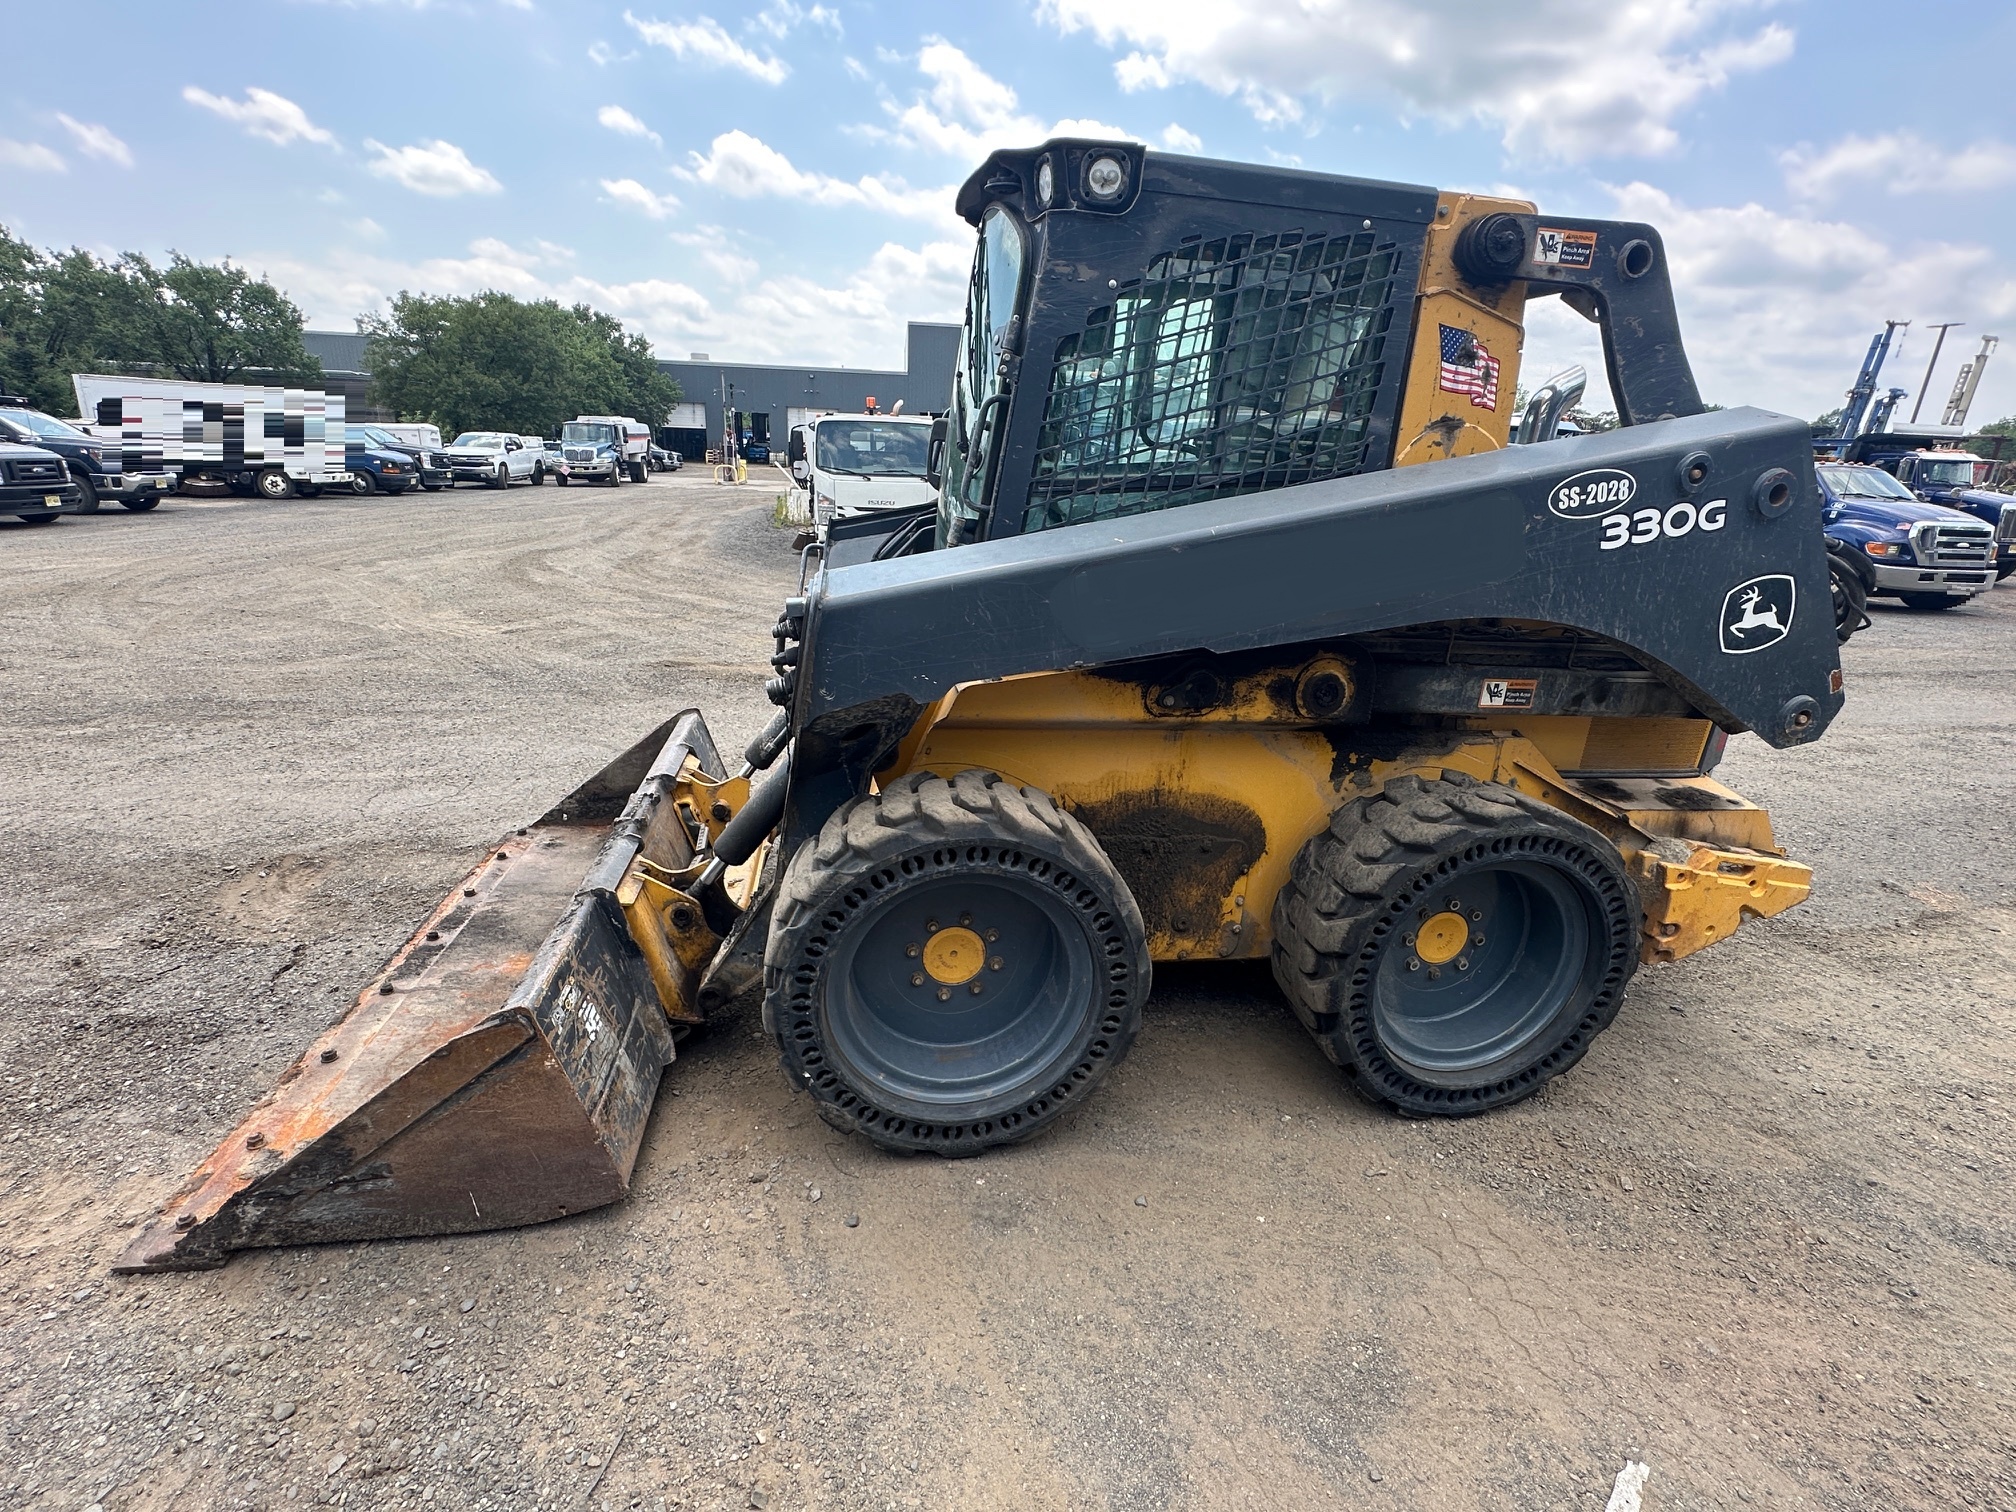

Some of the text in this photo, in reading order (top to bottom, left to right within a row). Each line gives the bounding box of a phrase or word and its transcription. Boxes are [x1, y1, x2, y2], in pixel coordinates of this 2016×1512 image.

[1571, 234, 1594, 242] WARNING
[1577, 247, 1590, 255] Area
[1558, 479, 1630, 510] SS-2028
[1600, 499, 1727, 550] 330G
